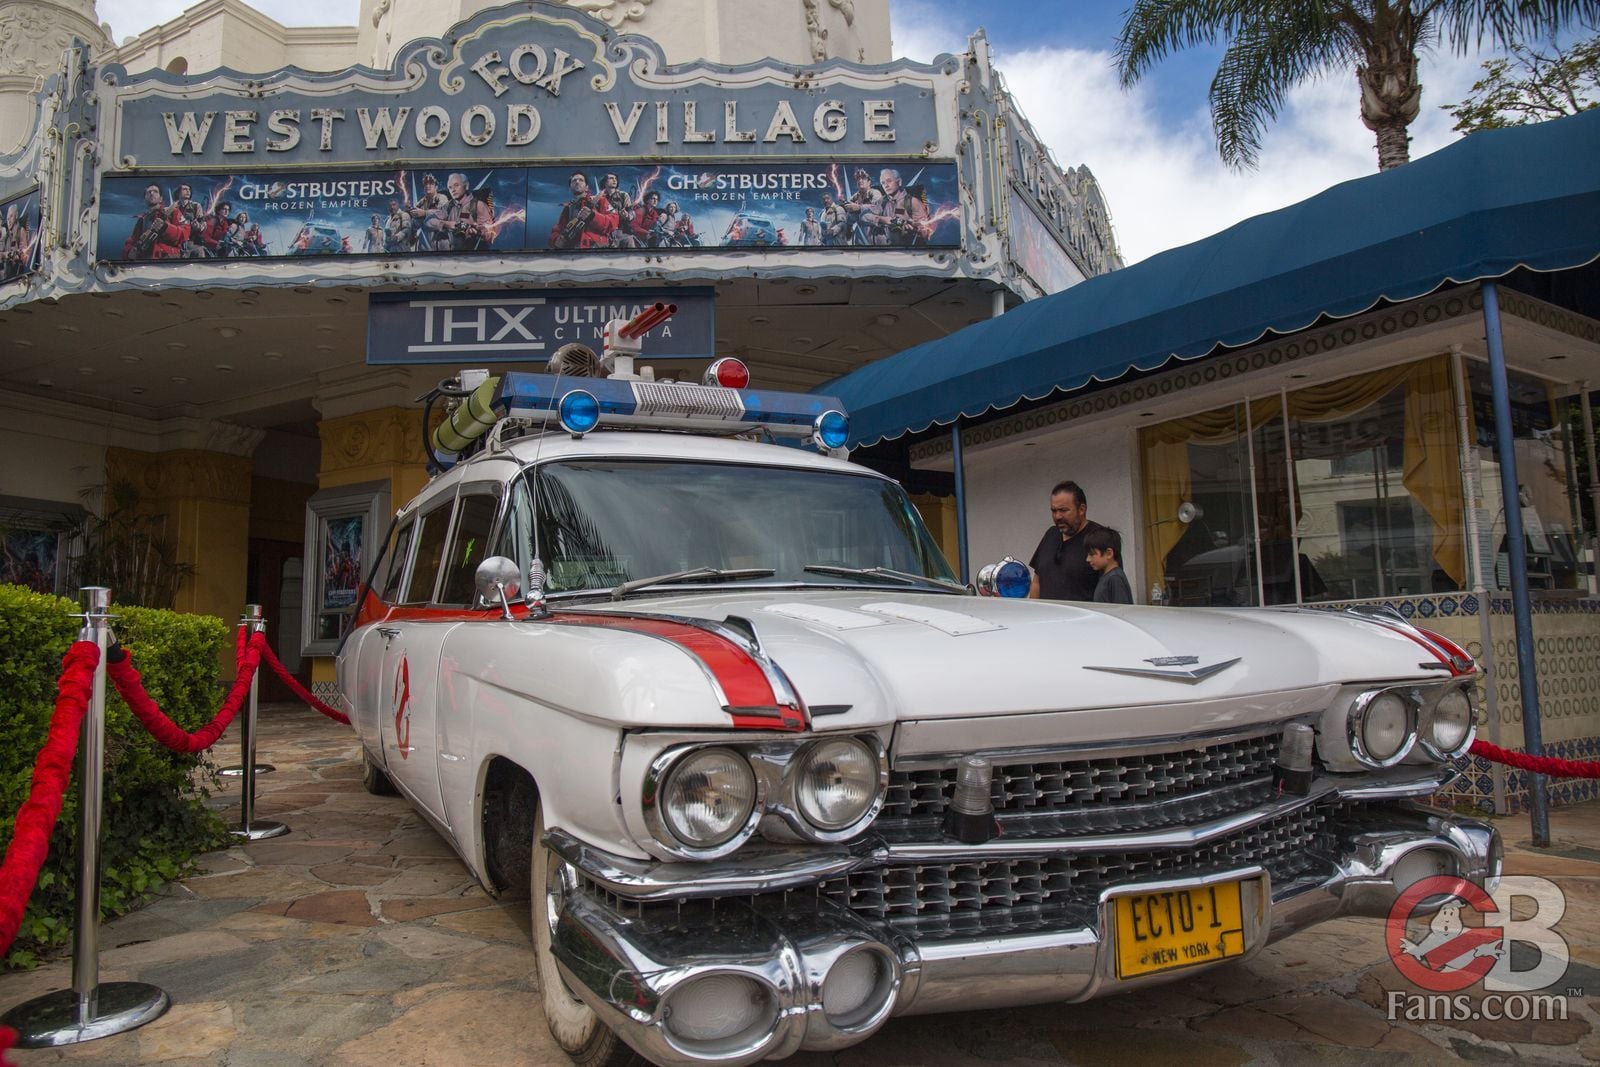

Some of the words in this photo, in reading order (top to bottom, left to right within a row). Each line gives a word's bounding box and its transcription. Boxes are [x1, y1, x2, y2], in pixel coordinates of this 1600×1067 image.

[470, 43, 586, 98] FOX
[161, 104, 541, 154] WESTWOOD
[604, 99, 896, 143] VILLAGE
[239, 180, 395, 200] GHOSTBUSTERS
[667, 172, 828, 190] GHOSTBUSTERS
[264, 201, 314, 210] FROZEN
[321, 199, 368, 209] EMPIRE
[694, 192, 746, 201] FROZEN
[753, 191, 801, 200] EMPIRE
[409, 298, 546, 343] THX
[554, 325, 672, 340] CINA
[1153, 948, 1178, 964] NEW
[1182, 942, 1211, 958] YORK
